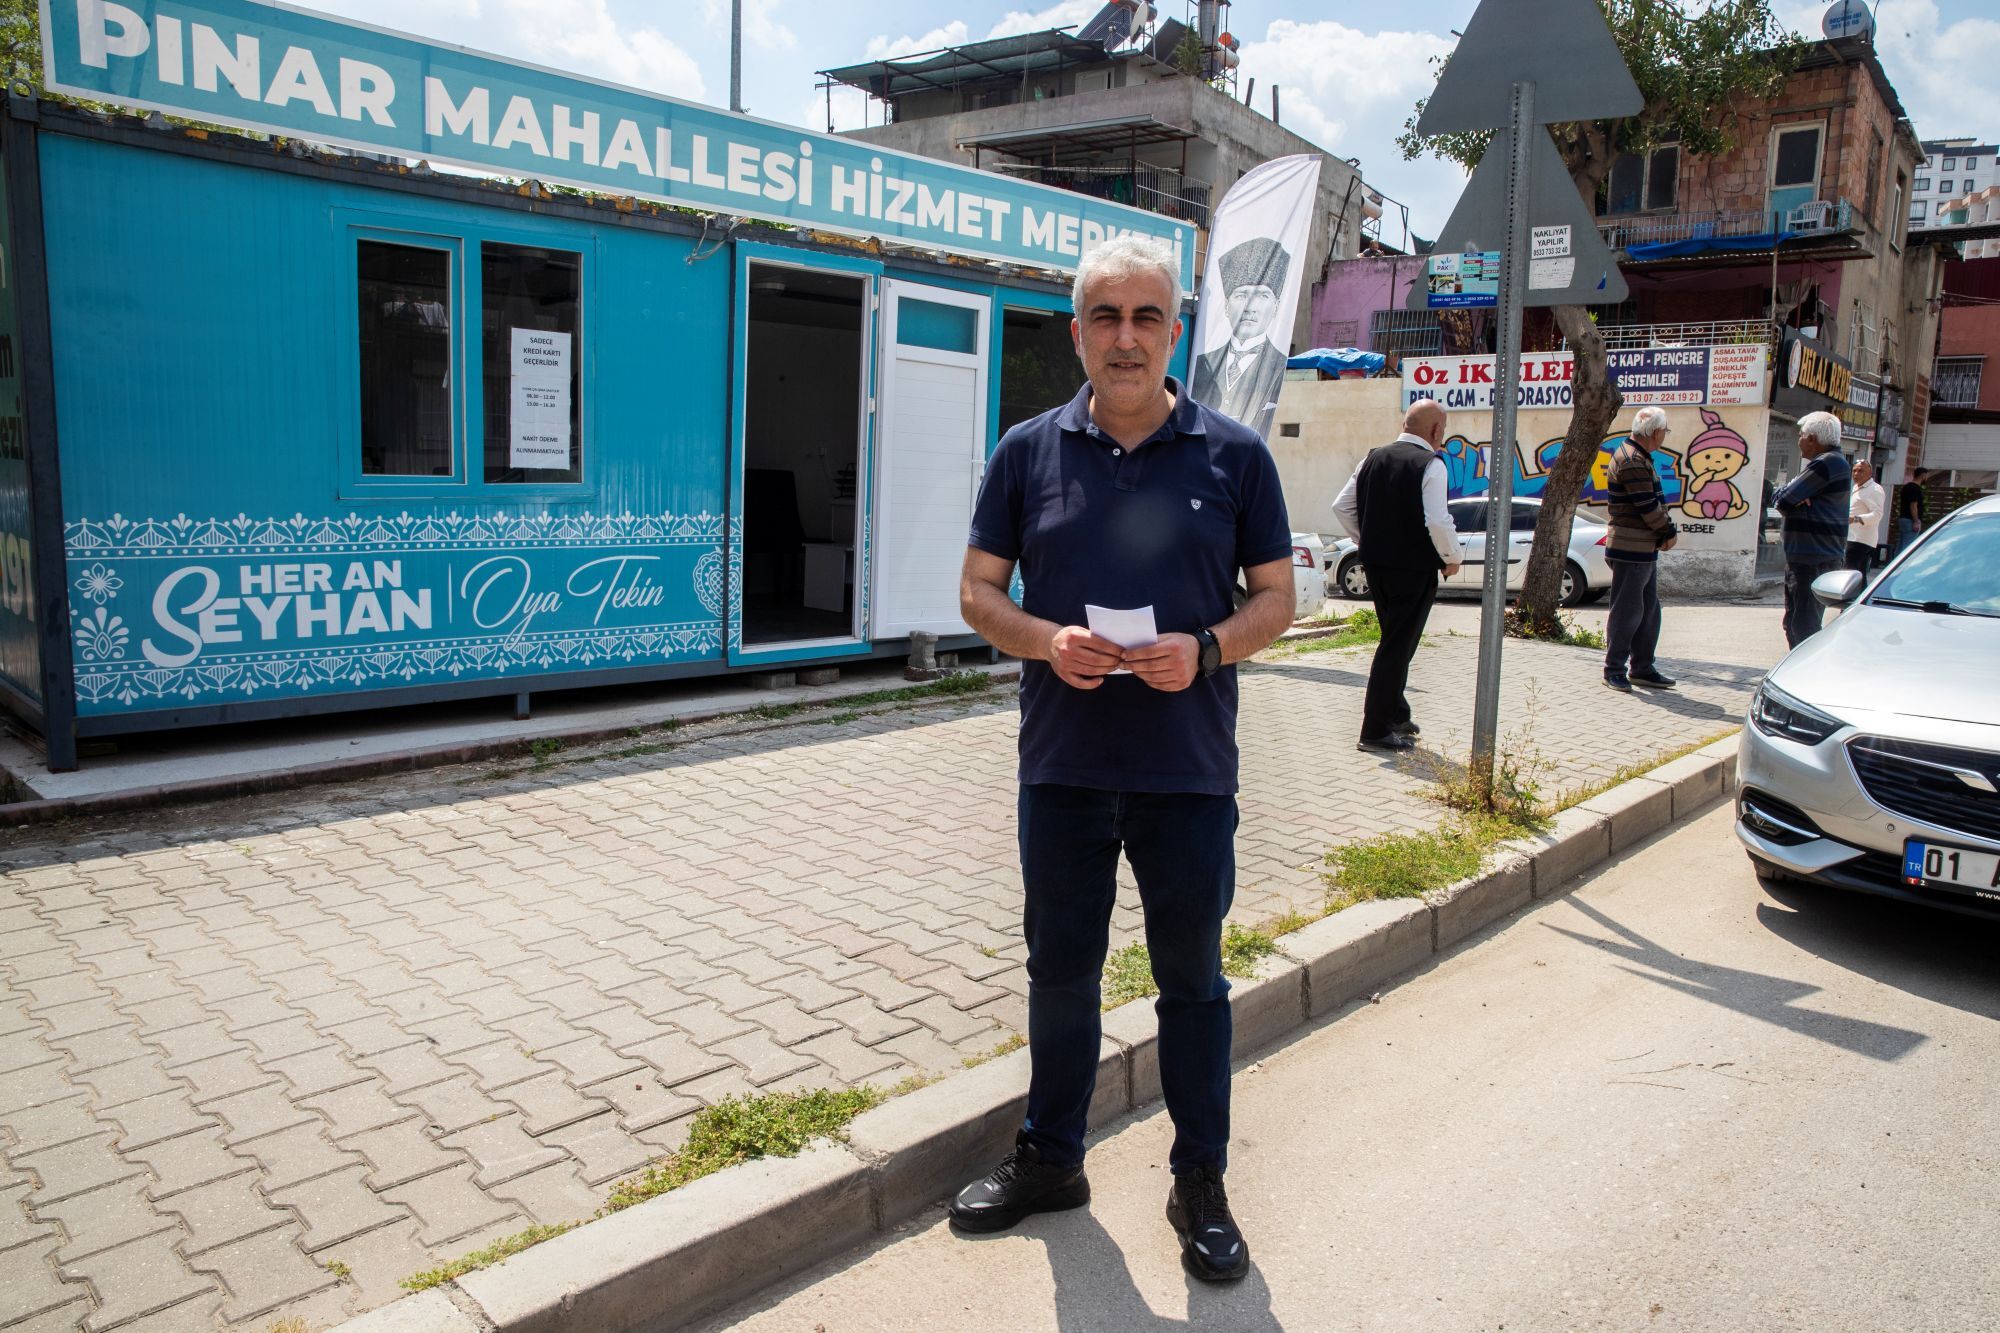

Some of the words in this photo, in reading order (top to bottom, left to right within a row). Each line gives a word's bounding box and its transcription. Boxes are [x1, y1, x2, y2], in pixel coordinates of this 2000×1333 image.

[77, 0, 396, 128] PINAR
[425, 76, 812, 206] MAHALLESİ
[831, 157, 1010, 242] HİZMET
[1537, 238, 1564, 247] YAPILIR
[529, 337, 553, 345] SADECE
[523, 347, 542, 355] KREDİ
[523, 357, 559, 367] GEÇERLİDİR
[1654, 351, 1704, 366] PENCERE
[1414, 361, 1448, 385] Öz
[1617, 369, 1679, 387] SİSTEMLERİ
[1712, 381, 1757, 389] ALÜMİNYUM
[1447, 388, 1475, 407] CAM
[1633, 394, 1642, 402] 13
[1644, 393, 1653, 402] 07
[1660, 393, 1675, 402] 224
[1678, 392, 1687, 401] 19
[1690, 391, 1699, 400] 21
[1711, 397, 1741, 405] KORNEJ
[515, 447, 564, 455] ALINMAMAKTADIR
[1680, 523, 1716, 534] BEBEE
[240, 563, 333, 595] HER
[342, 560, 402, 591] AN
[460, 555, 563, 651] Oya
[567, 555, 664, 626] Tekin
[141, 565, 432, 667] SEYHAN
[1908, 862, 1922, 871] TR
[1926, 848, 1960, 881] 01
